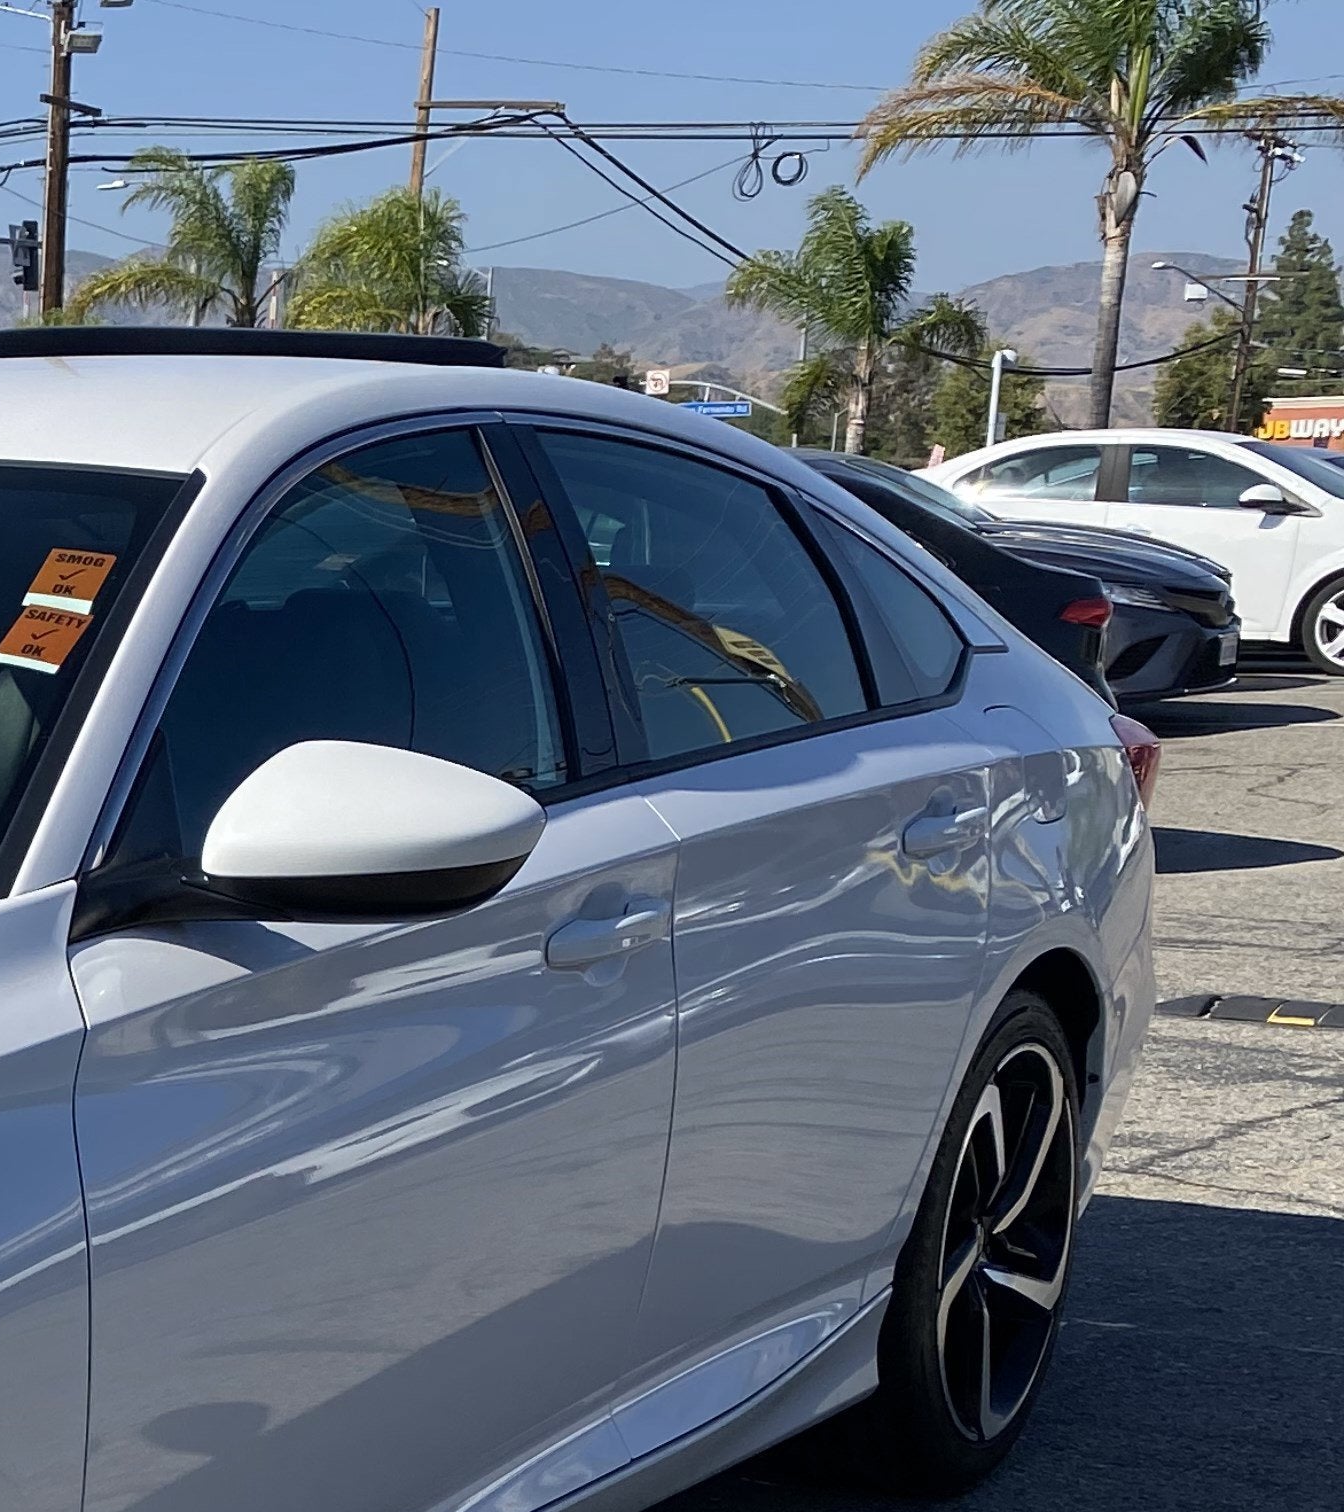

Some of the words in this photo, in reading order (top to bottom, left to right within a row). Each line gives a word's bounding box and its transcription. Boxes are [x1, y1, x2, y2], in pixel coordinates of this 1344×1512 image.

[55, 553, 106, 567] SMOG
[52, 584, 76, 595] OK
[25, 609, 85, 629] SAFETY
[21, 644, 47, 656] OK
